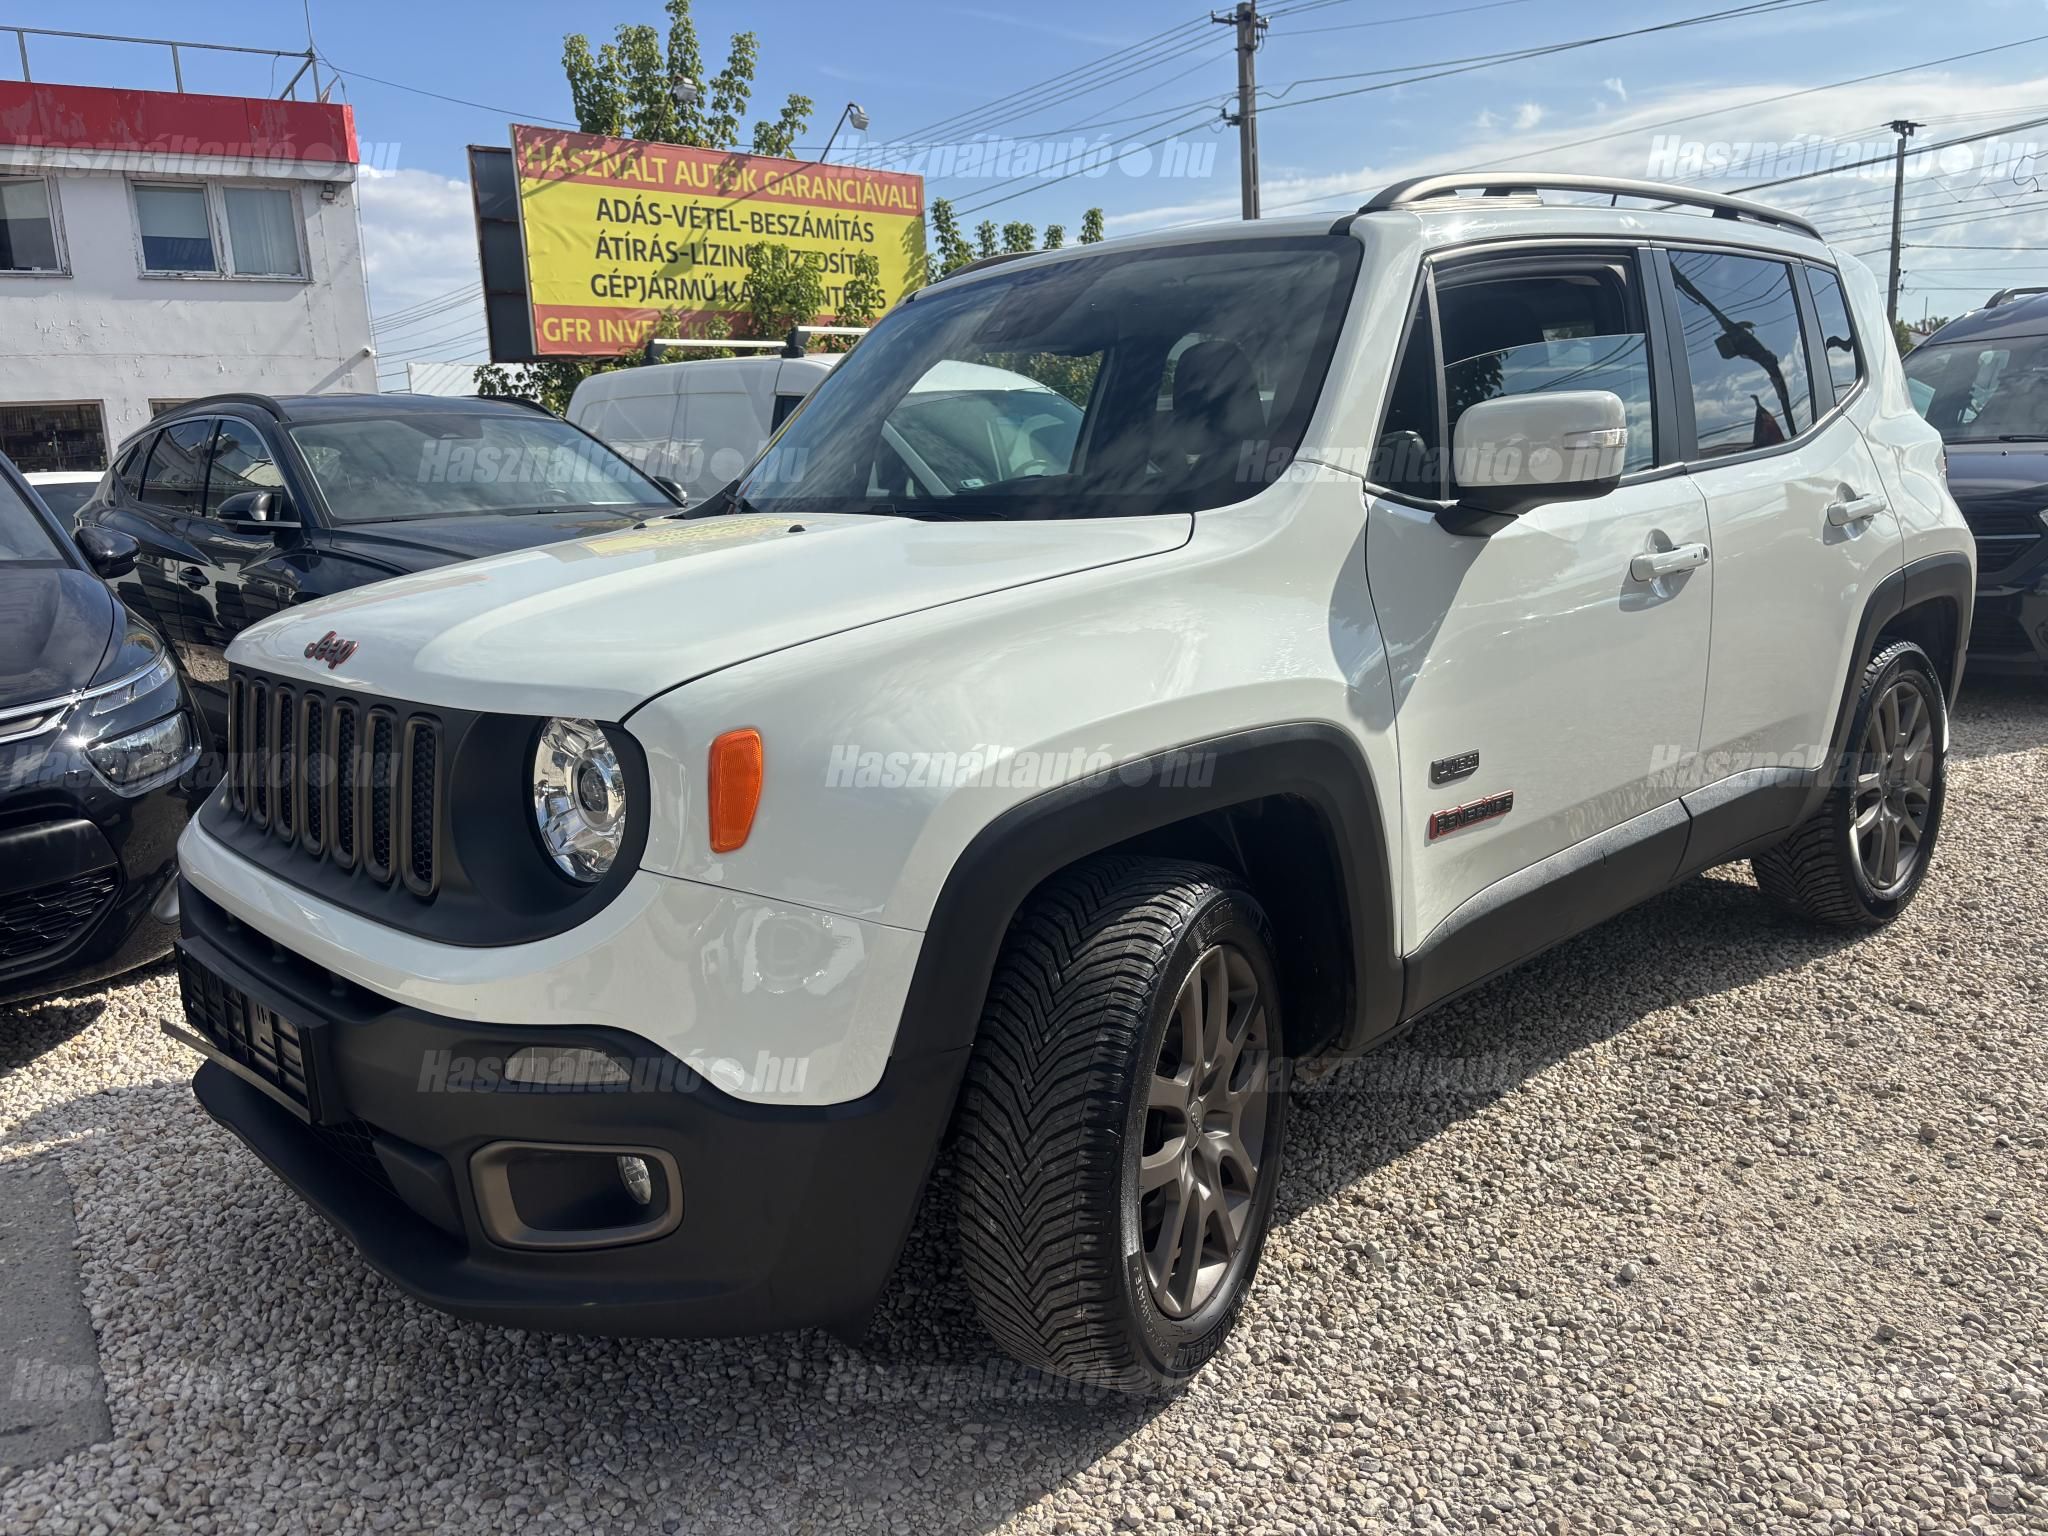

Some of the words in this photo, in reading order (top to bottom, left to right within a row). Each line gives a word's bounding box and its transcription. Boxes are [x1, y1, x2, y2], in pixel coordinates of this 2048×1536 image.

[525, 142, 668, 186] HASZNÁLT
[674, 156, 758, 193] AUTÓK
[764, 170, 918, 210] GARANCIÁVAL!
[590, 272, 717, 302] GÉPJÁRMŰ
[542, 317, 593, 343] GFR
[303, 630, 360, 670] Jeep
